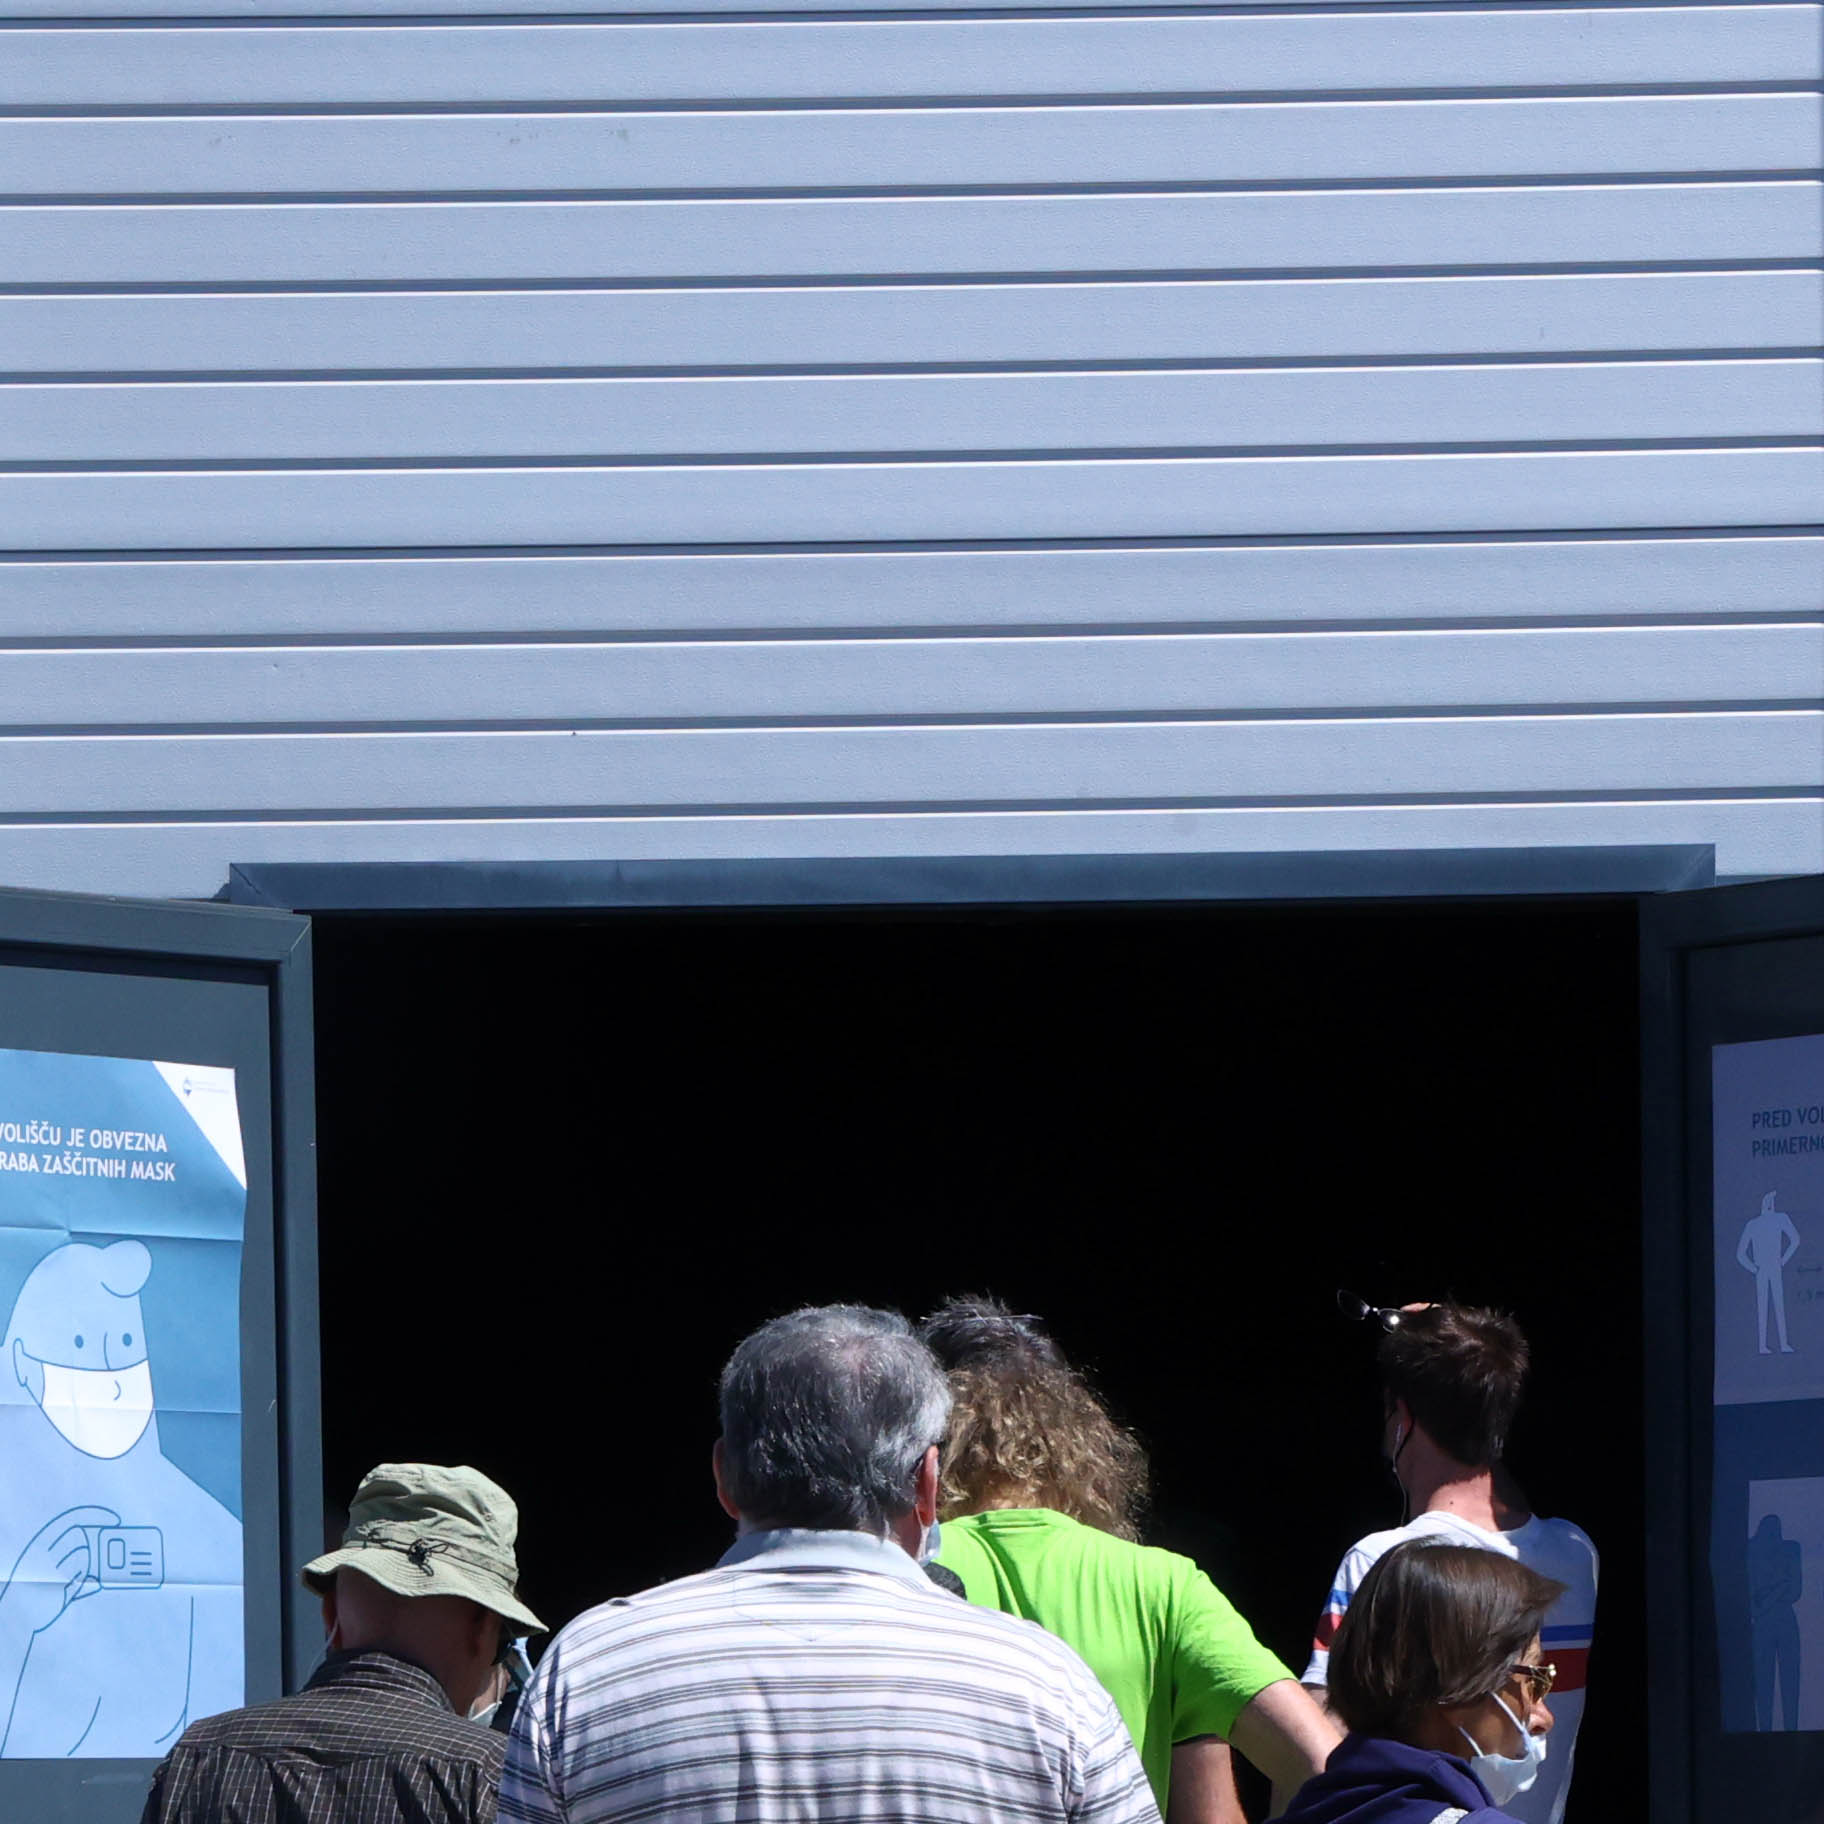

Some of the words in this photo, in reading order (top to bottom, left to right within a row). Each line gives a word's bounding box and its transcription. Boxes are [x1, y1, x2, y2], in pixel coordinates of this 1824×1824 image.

[1752, 1108, 1791, 1129] PRED
[65, 1127, 85, 1148] JE
[90, 1129, 167, 1152] OBVEZNA
[43, 1152, 125, 1178] ZAŠČITNIH
[131, 1161, 175, 1182] MASK
